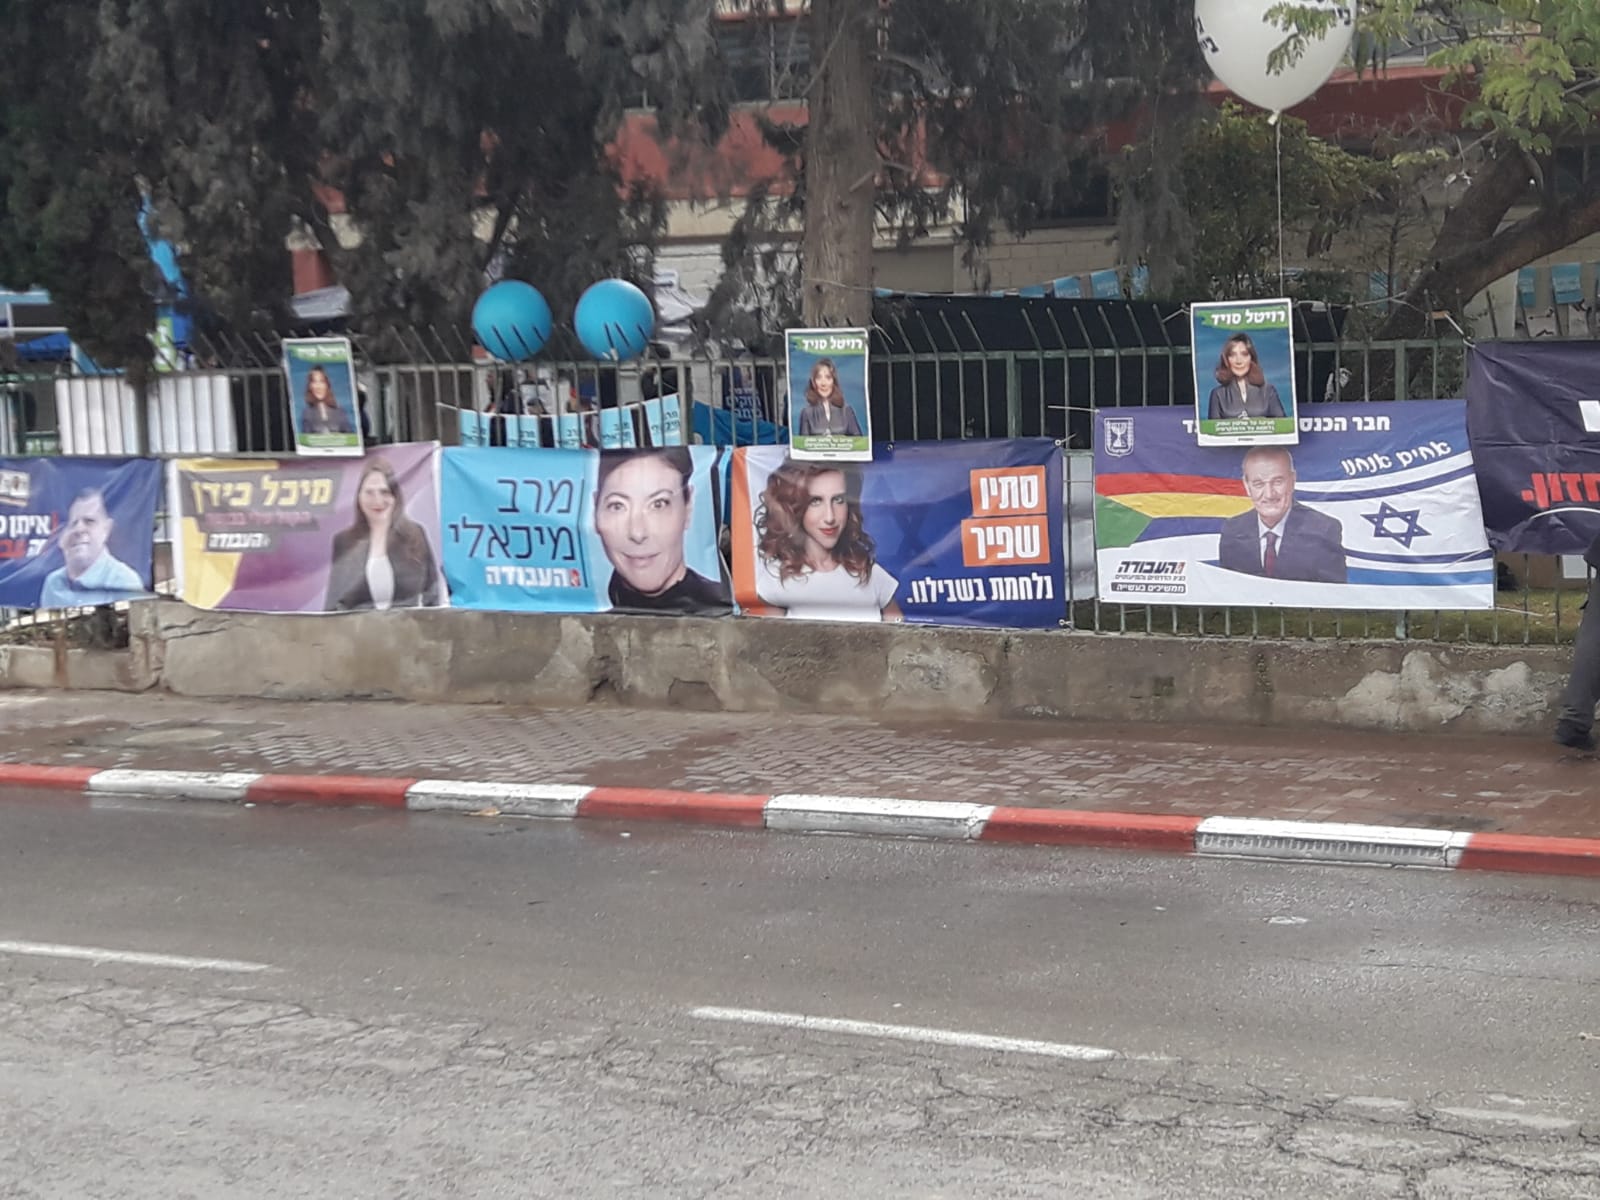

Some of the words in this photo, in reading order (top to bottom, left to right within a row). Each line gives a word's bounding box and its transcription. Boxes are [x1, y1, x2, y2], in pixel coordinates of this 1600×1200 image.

[1298, 416, 1348, 433] הכנס
[1351, 415, 1391, 432] חבר
[1341, 453, 1393, 476] אנחנו
[1396, 441, 1452, 467] אחים
[261, 474, 333, 507] מיכל
[497, 478, 574, 514] מרב
[980, 474, 1040, 511] סתיו
[8, 514, 51, 539] איתן
[448, 516, 576, 561] מיכאלי
[970, 524, 1041, 560] שפיר
[485, 565, 569, 587] העבודה
[1117, 560, 1179, 574] העבודה
[906, 576, 987, 603] בשבילנו.
[988, 571, 1054, 601] נלחמת
